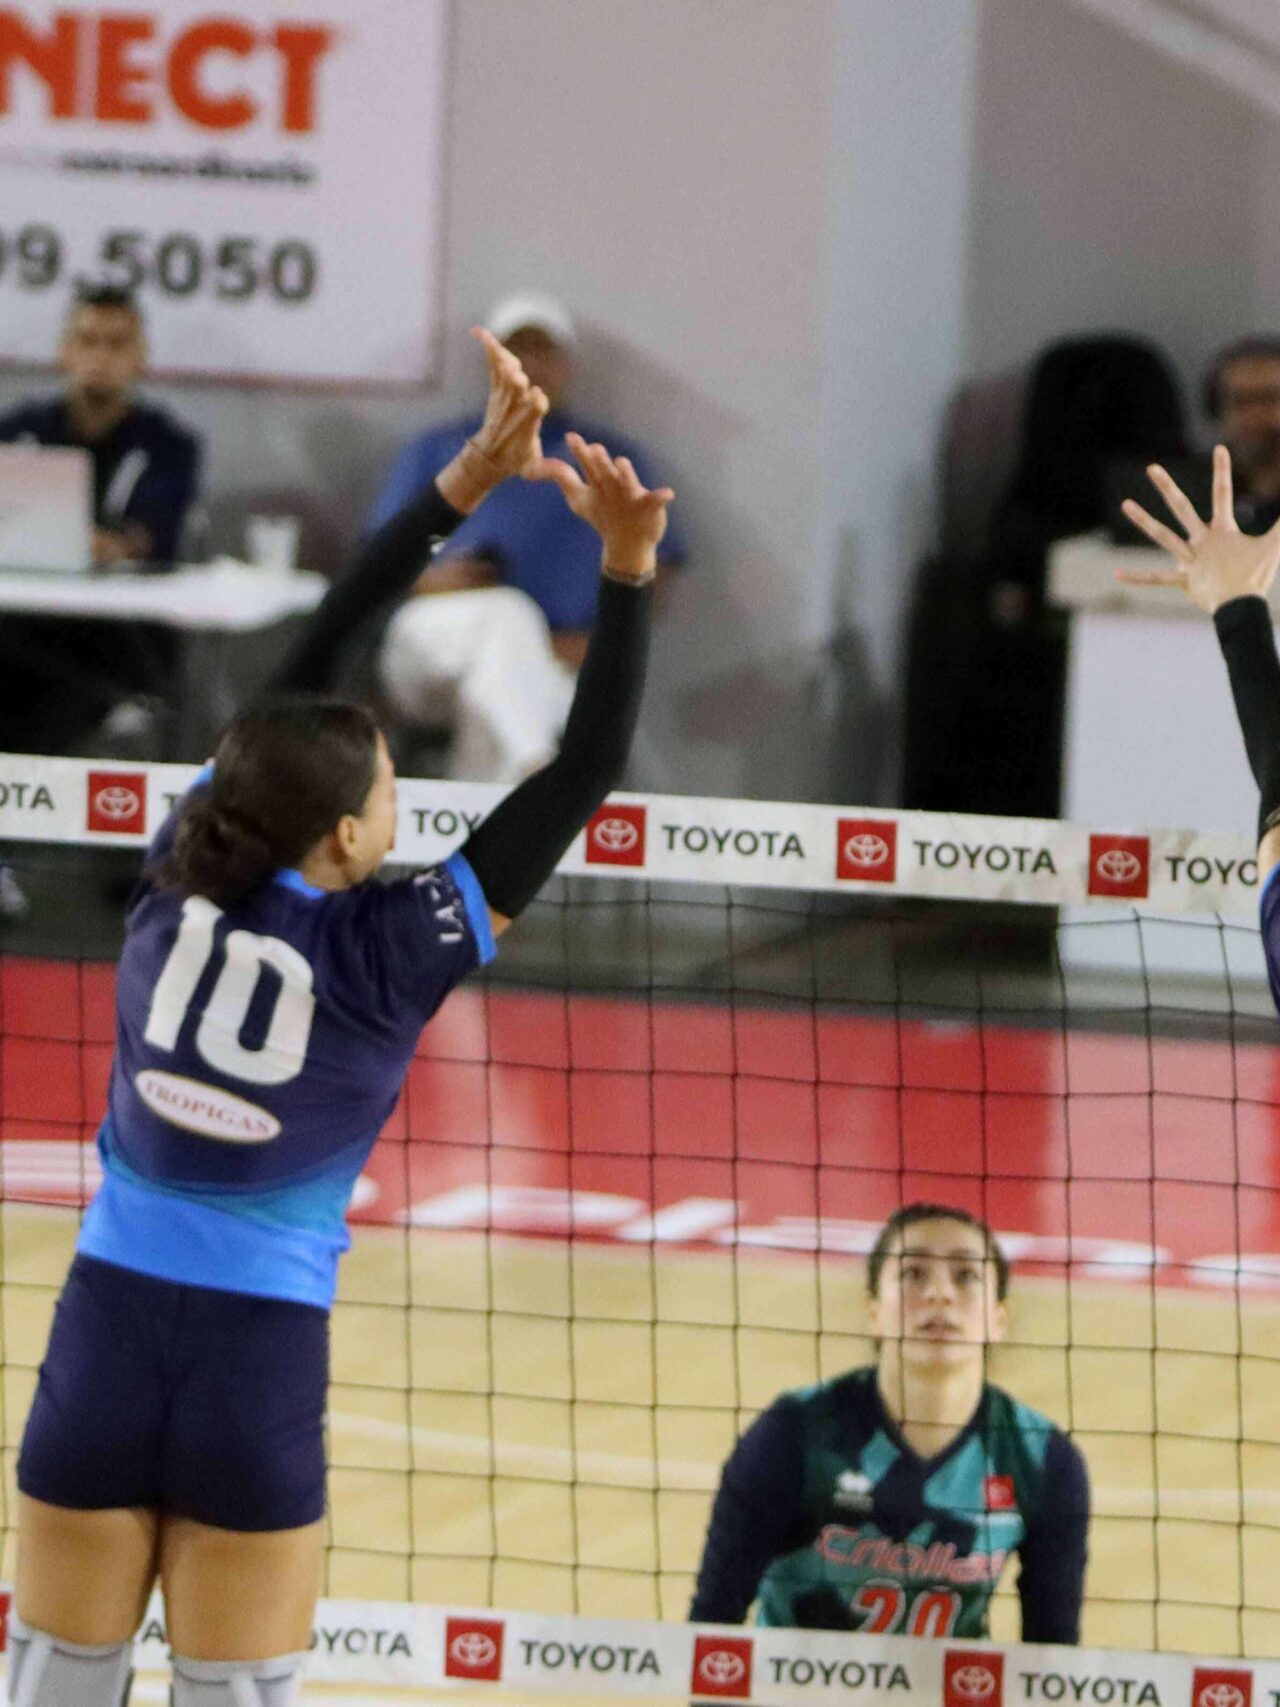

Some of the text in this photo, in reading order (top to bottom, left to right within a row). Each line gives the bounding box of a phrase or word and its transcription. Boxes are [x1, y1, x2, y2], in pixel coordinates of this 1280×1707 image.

[411, 807, 482, 836] TOY
[662, 824, 805, 859] TOYOTA
[913, 840, 1057, 874] TOYOTA
[1164, 856, 1258, 886] TOYO
[144, 896, 315, 1086] 10
[309, 1627, 412, 1658] YOTA
[520, 1639, 660, 1676] TOYOTA
[769, 1656, 911, 1691] TOYOTA
[1020, 1672, 1161, 1705] TOYOTA
